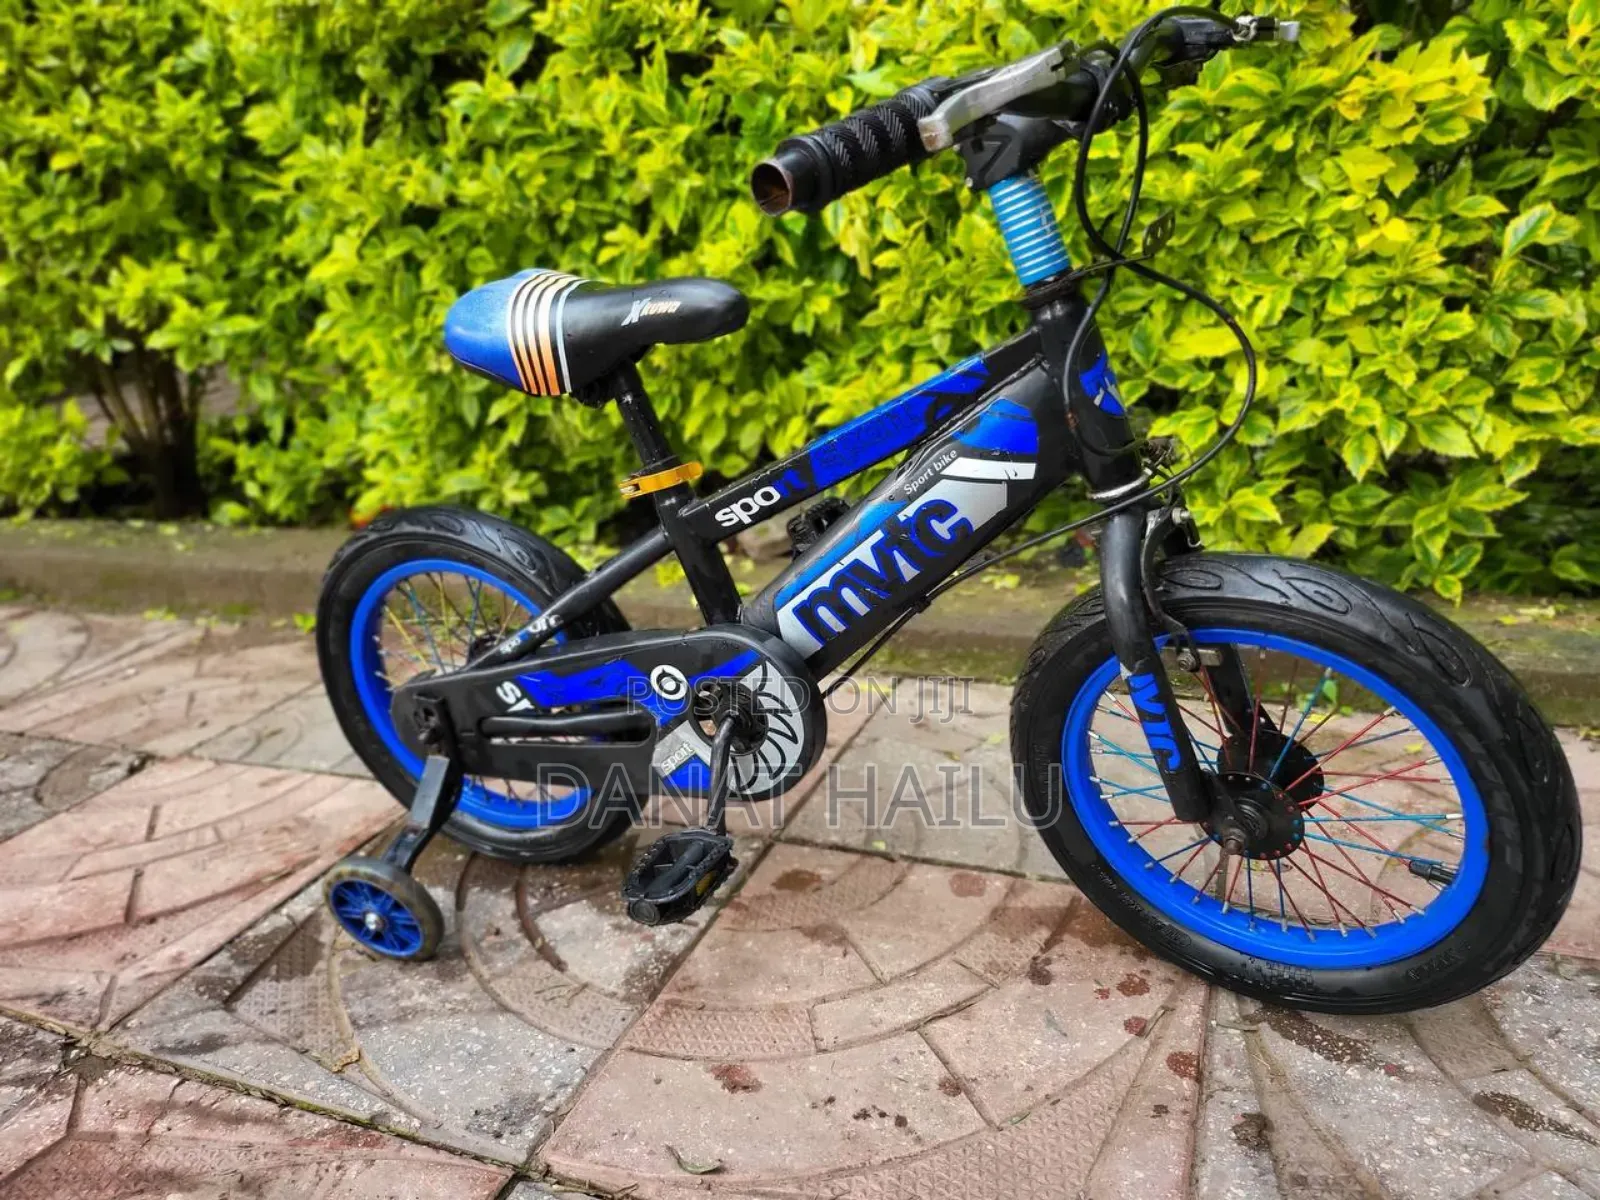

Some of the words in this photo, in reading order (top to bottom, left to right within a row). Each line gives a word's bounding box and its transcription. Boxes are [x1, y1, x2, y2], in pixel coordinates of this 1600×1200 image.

[903, 468, 934, 495] Sport
[933, 449, 957, 472] bike
[661, 740, 694, 775] sport
